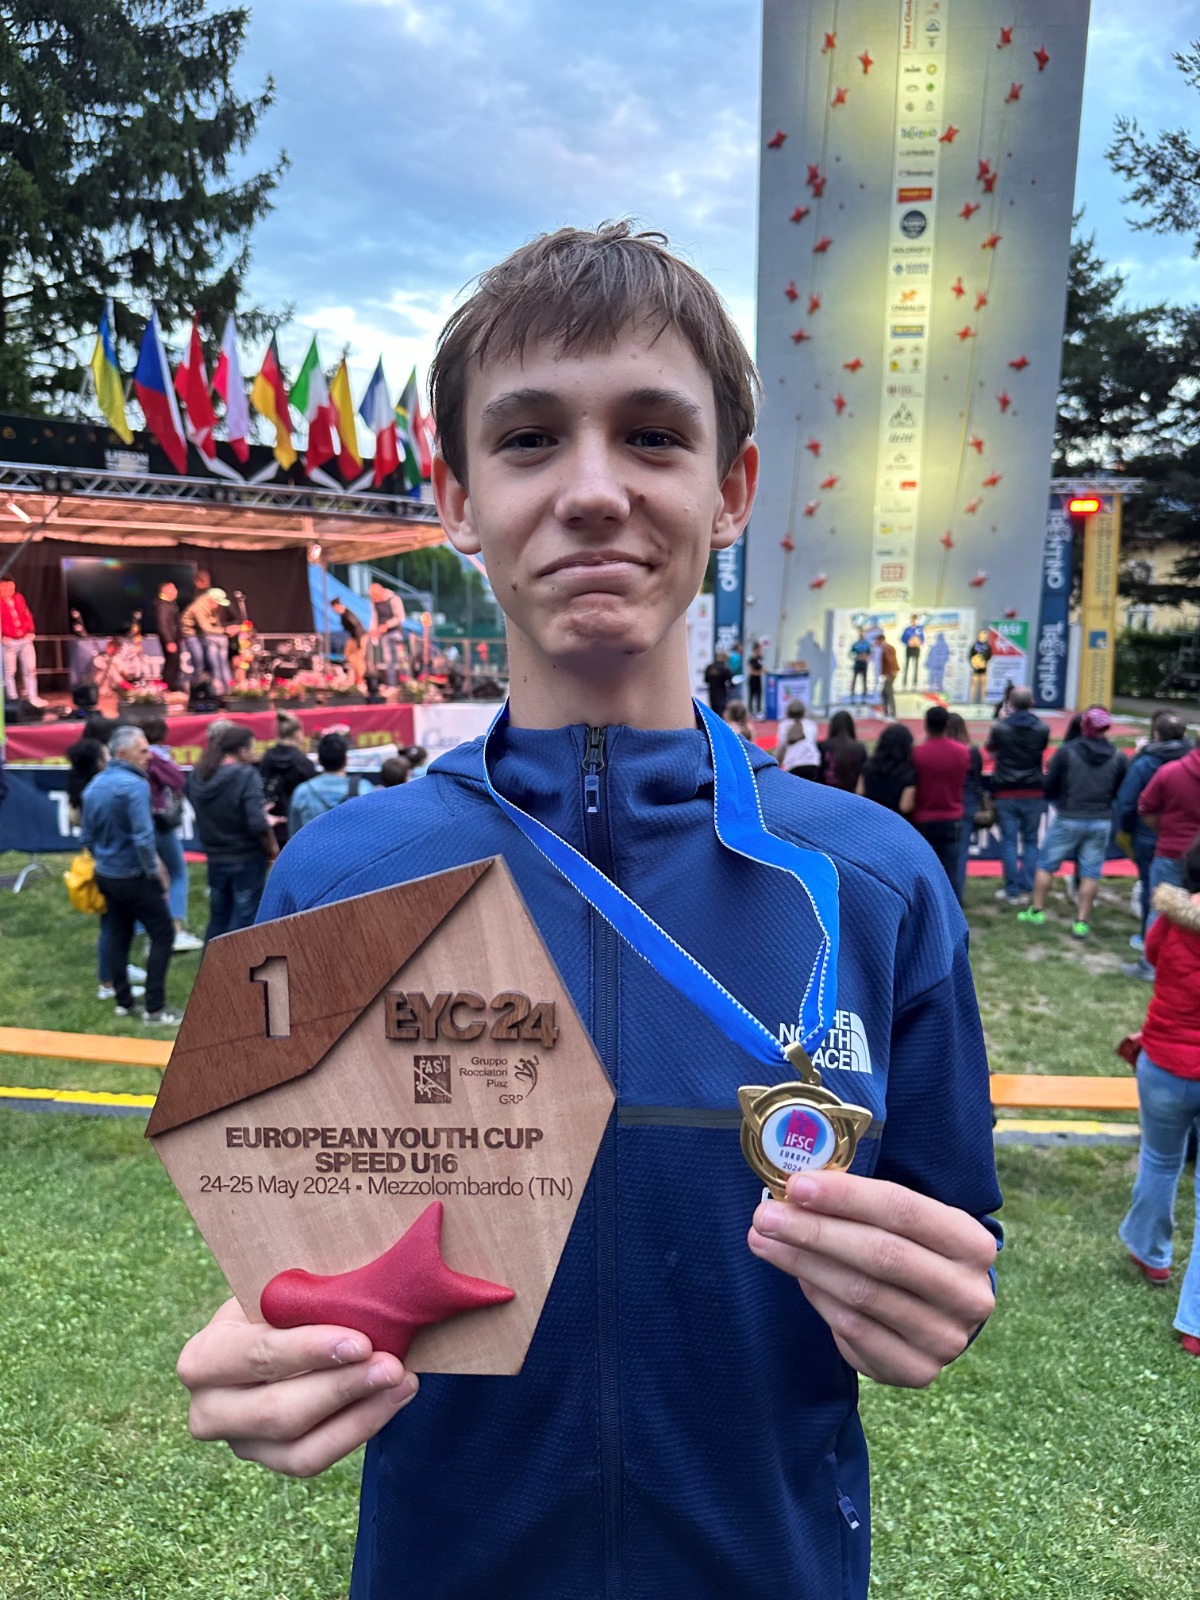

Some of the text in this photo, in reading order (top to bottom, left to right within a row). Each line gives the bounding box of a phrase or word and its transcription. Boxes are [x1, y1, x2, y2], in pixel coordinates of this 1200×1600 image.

[249, 955, 291, 1039] 1
[383, 990, 560, 1049] EYC24
[833, 1009, 850, 1030] HE
[779, 1022, 850, 1051] NTH
[471, 1056, 508, 1068] Gruppo
[812, 1047, 851, 1071] ACE
[459, 1067, 508, 1077] Rocciatori
[487, 1079, 508, 1089] Piaz
[499, 1094, 524, 1105] GRP
[225, 1126, 544, 1149] EUROPEAN YOUTH CUP
[315, 1152, 459, 1174] SPEED U16
[779, 1149, 811, 1165] EUROPE
[200, 1175, 573, 1200] 24-25 May 2024 Mezzolombardo (TN)
